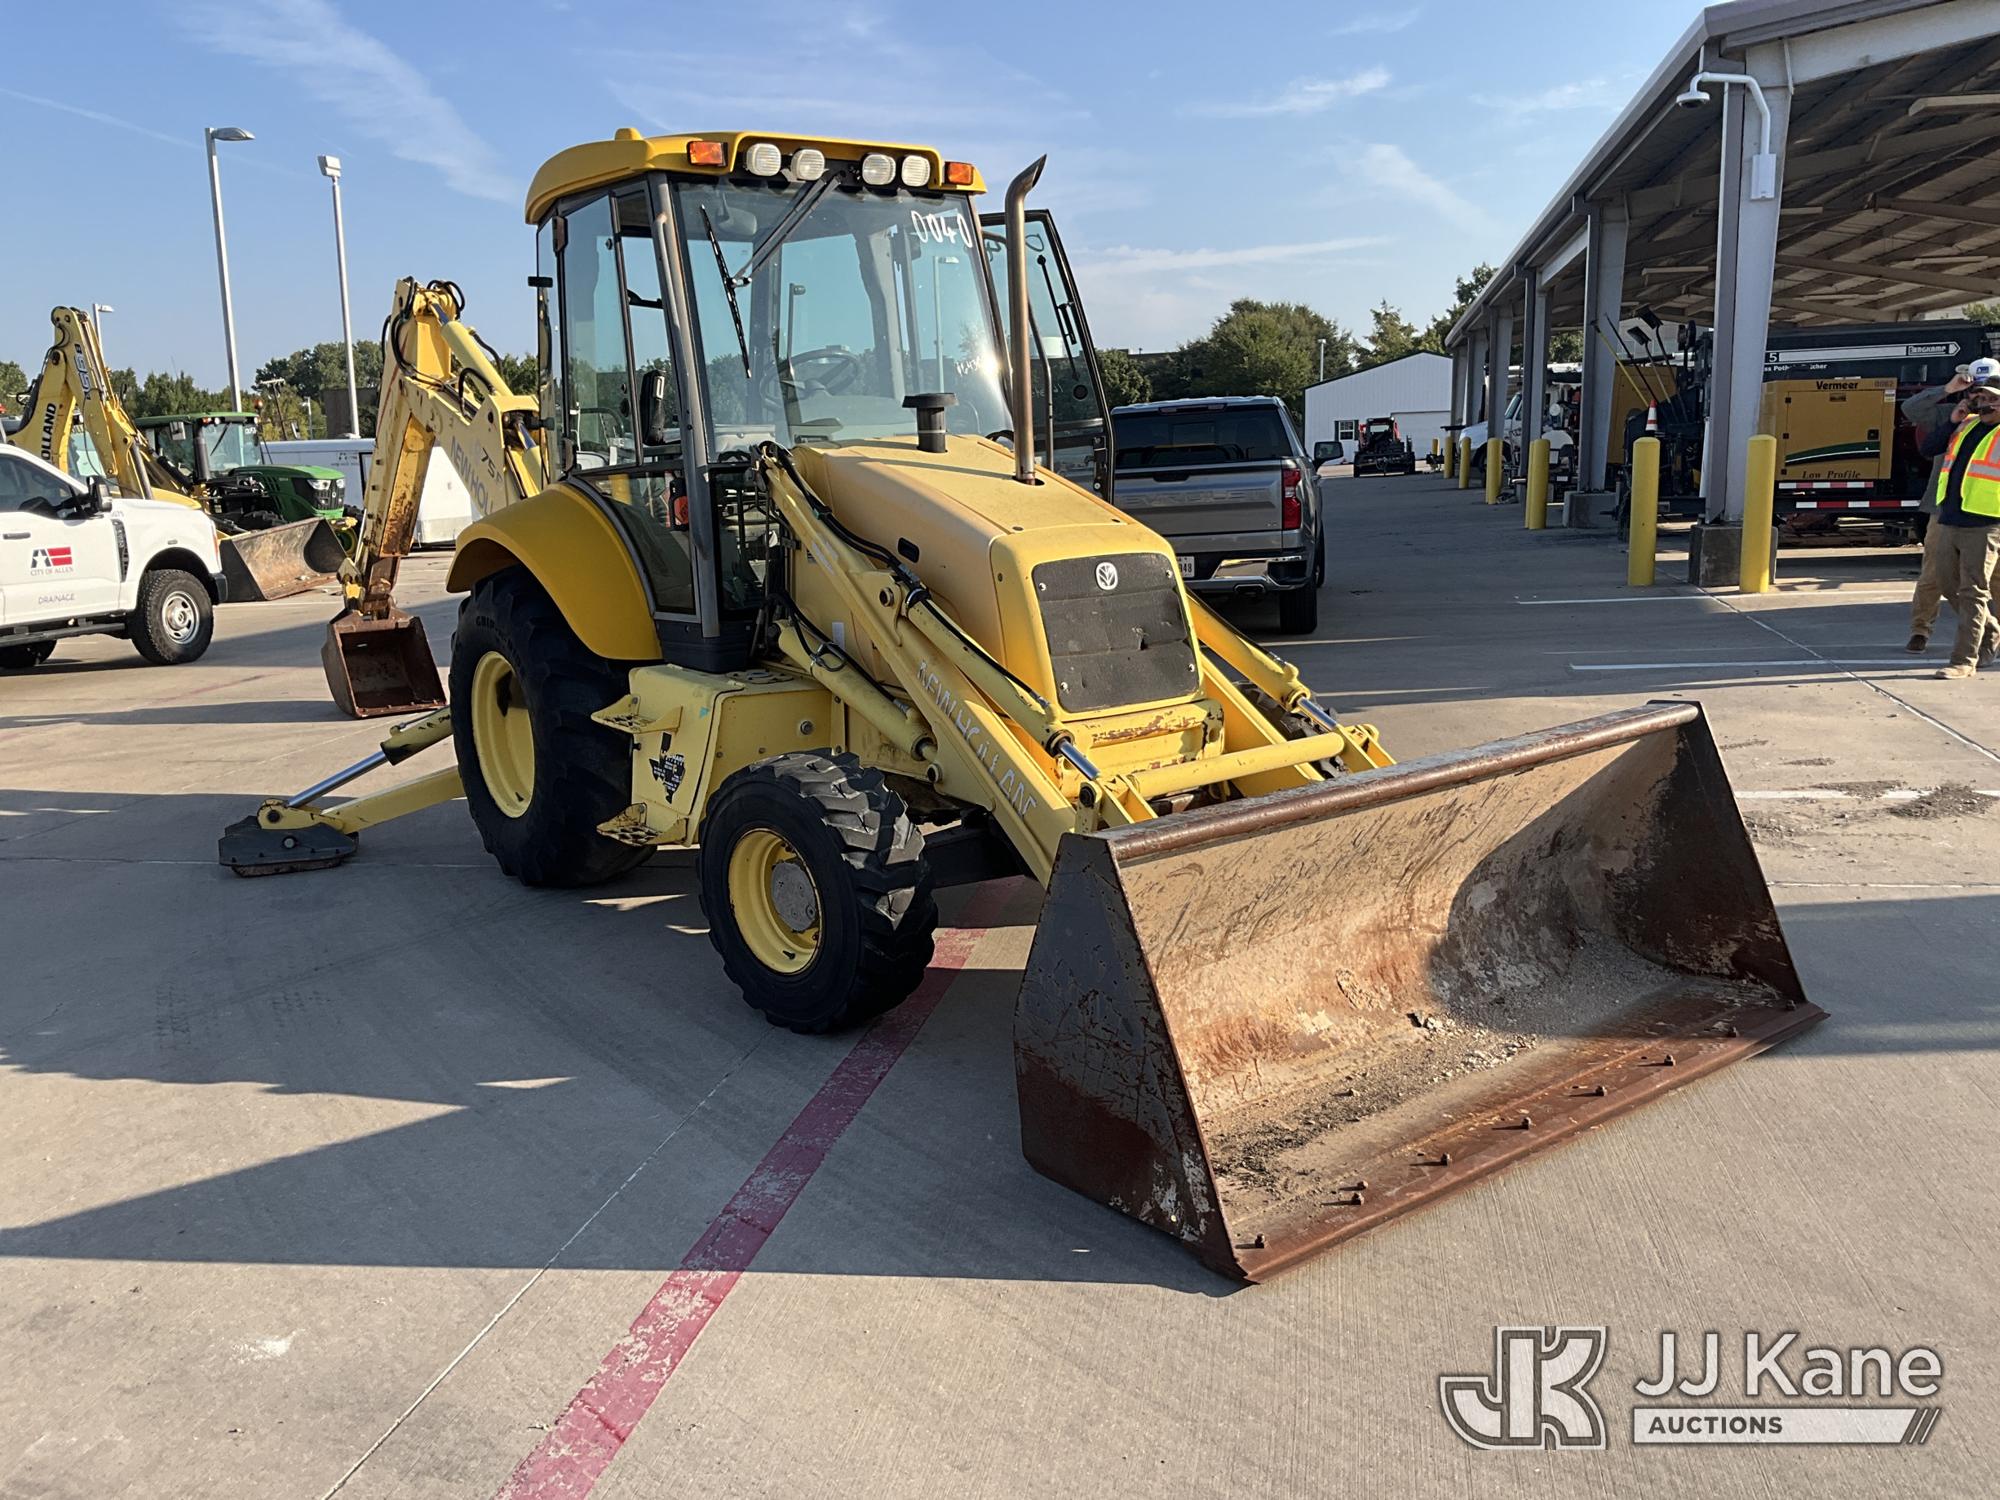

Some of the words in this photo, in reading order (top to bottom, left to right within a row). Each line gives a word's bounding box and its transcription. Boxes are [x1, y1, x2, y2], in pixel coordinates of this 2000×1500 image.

[911, 210, 973, 248] 0040
[1816, 380, 1859, 391] Vermeer
[40, 402, 57, 461] OLLAND
[1827, 470, 1862, 479] Profile
[38, 594, 76, 605] DRAINAGE
